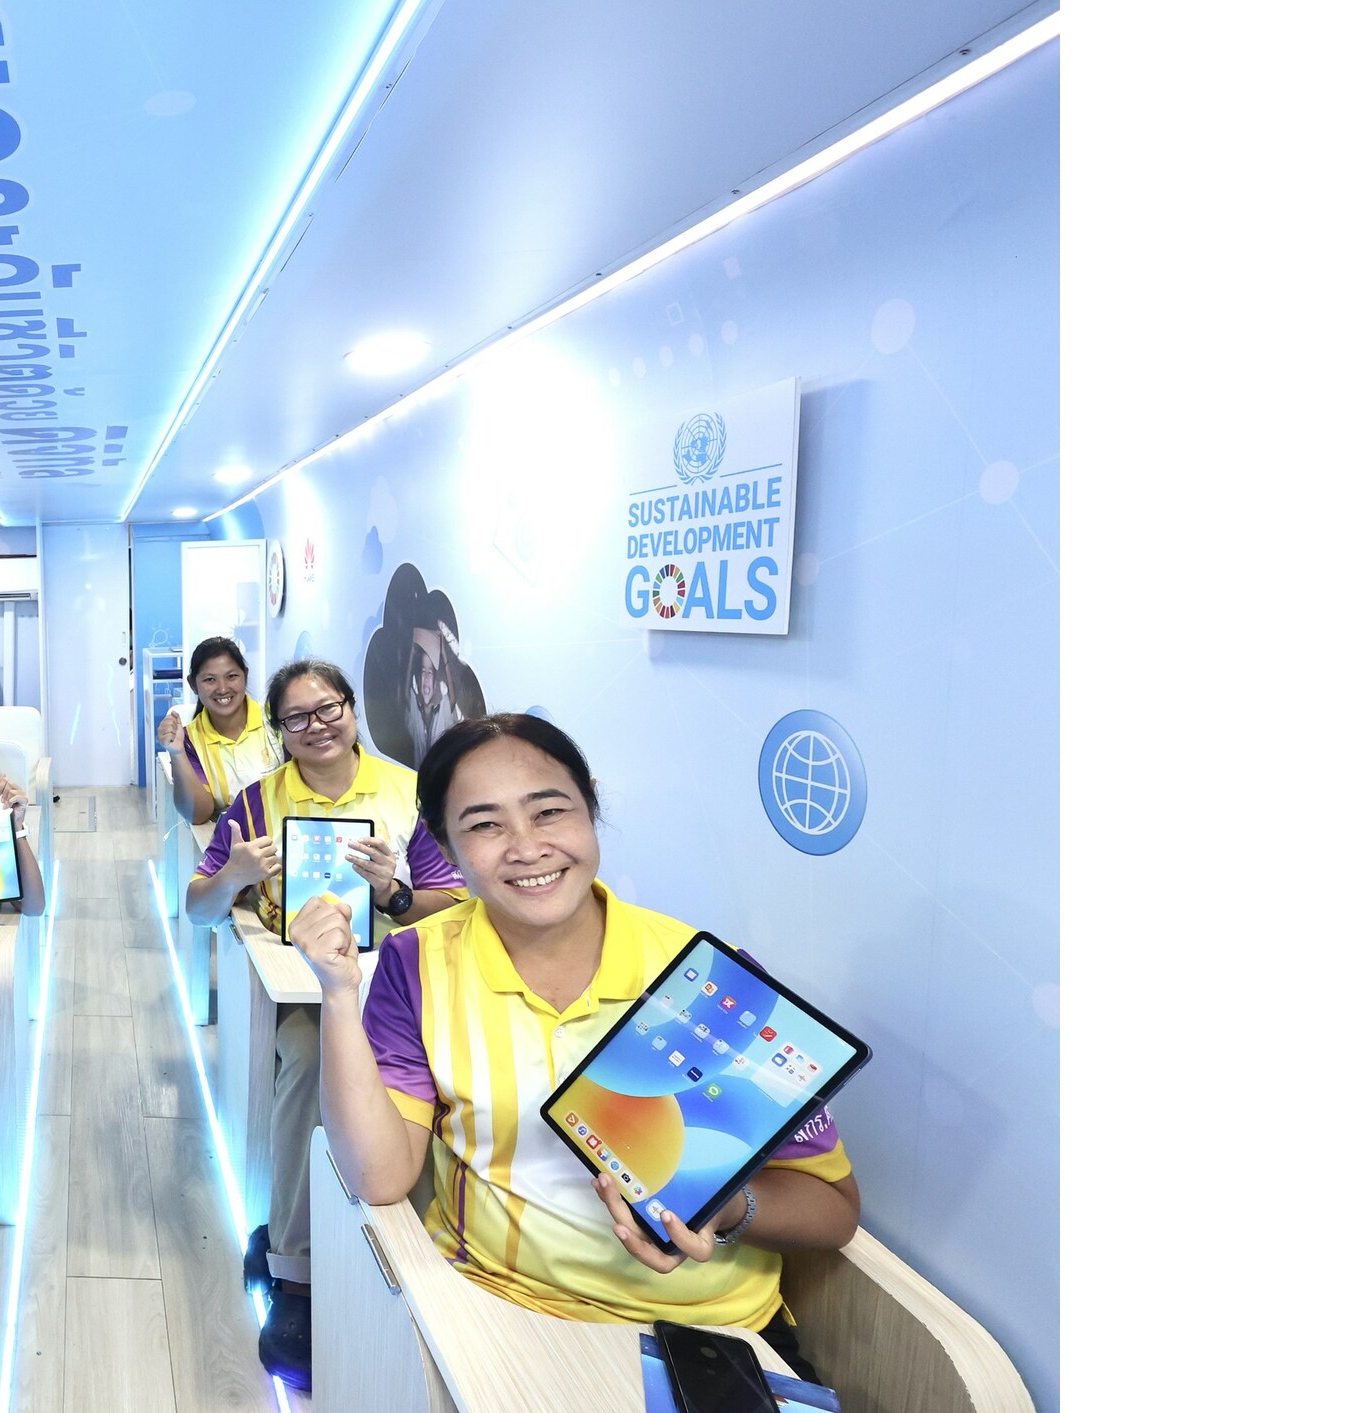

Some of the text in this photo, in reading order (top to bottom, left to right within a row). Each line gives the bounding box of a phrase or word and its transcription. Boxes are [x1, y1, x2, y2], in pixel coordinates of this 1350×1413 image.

[628, 477, 782, 527] SUSTAINABLE
[627, 517, 780, 559] DEVELOPMENT
[625, 556, 779, 621] GOALS
